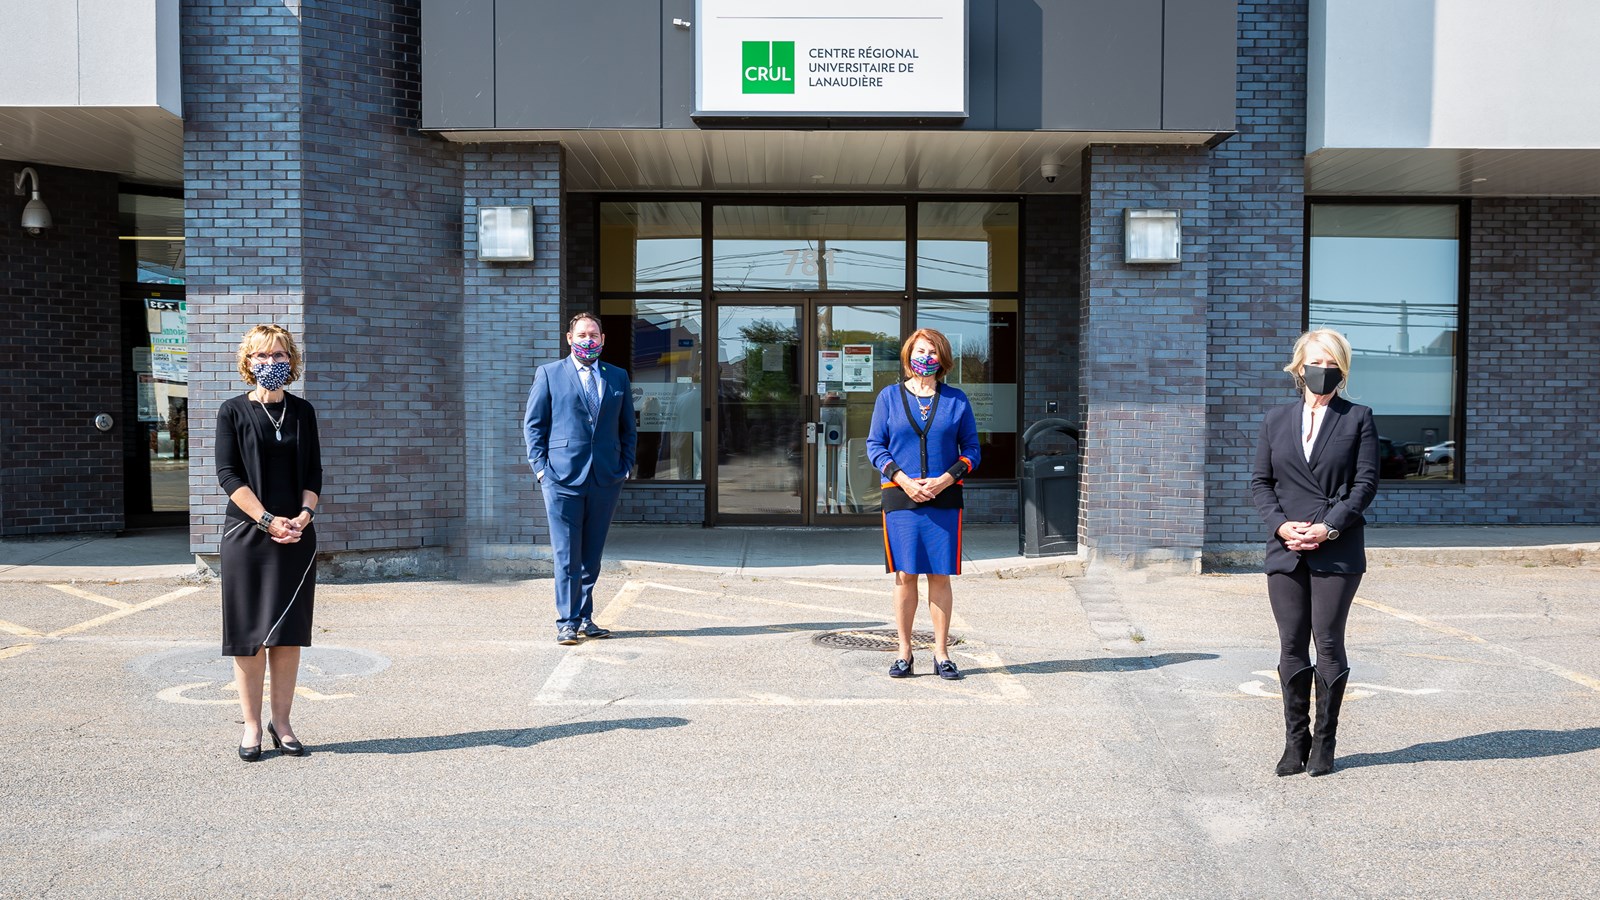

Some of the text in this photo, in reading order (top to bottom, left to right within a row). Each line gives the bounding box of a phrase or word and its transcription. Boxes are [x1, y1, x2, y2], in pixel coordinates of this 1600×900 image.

[808, 46, 919, 58] CENTRE RÉGIONAL
[745, 66, 791, 81] CRUL
[808, 62, 914, 73] UNIVERSITAIRE DE
[808, 75, 883, 87] LANAUDIÈRE
[783, 250, 834, 276] 781
